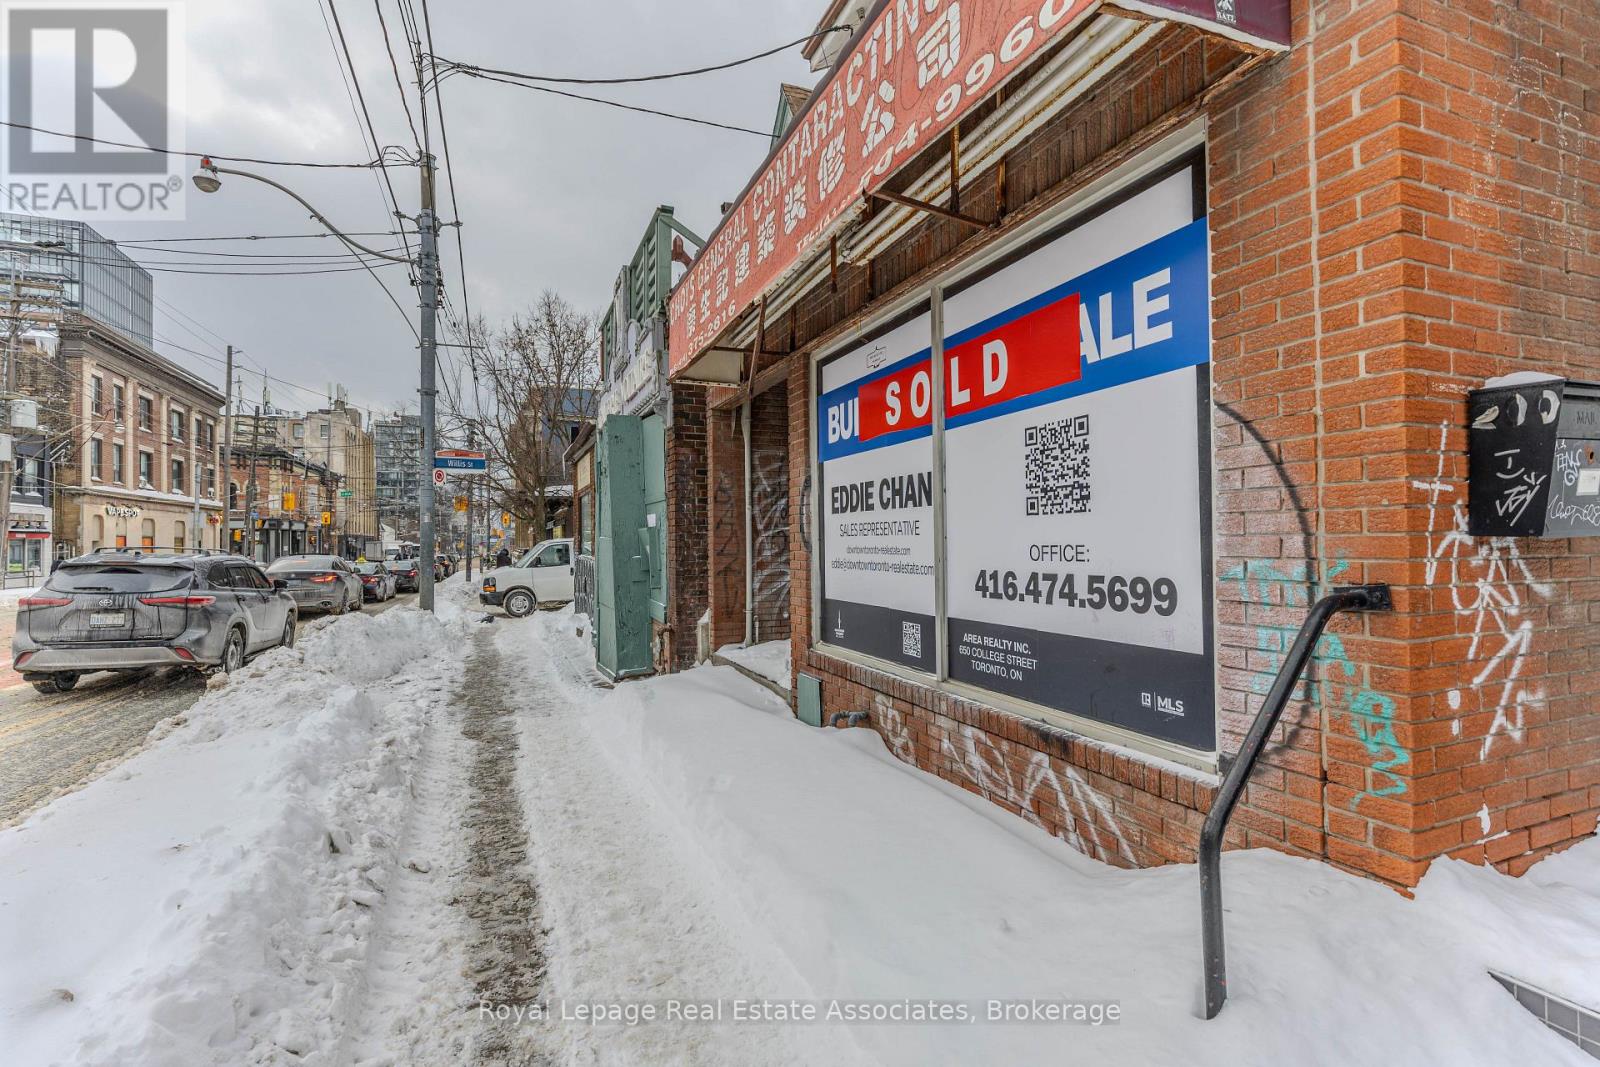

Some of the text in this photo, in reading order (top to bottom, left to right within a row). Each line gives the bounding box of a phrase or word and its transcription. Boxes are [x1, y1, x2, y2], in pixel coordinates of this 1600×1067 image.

[698, 205, 748, 291] GENERAL
[753, 0, 939, 221] CONTARACTIN
[1079, 267, 1173, 366] ALE
[885, 338, 1009, 426] SOLD
[447, 459, 466, 468] Willis
[831, 471, 933, 514] EDDIE CHAN
[839, 520, 920, 537] SALES REPRESENTATIVE
[1029, 544, 1090, 563] OFFICE:
[974, 569, 1178, 617] 416.474.5699
[962, 632, 1031, 655] AREA REALTY INC.
[959, 644, 1038, 670] 650 COLLEGE STREET
[1009, 668, 1022, 681] ON
[1157, 695, 1184, 713] MLS
